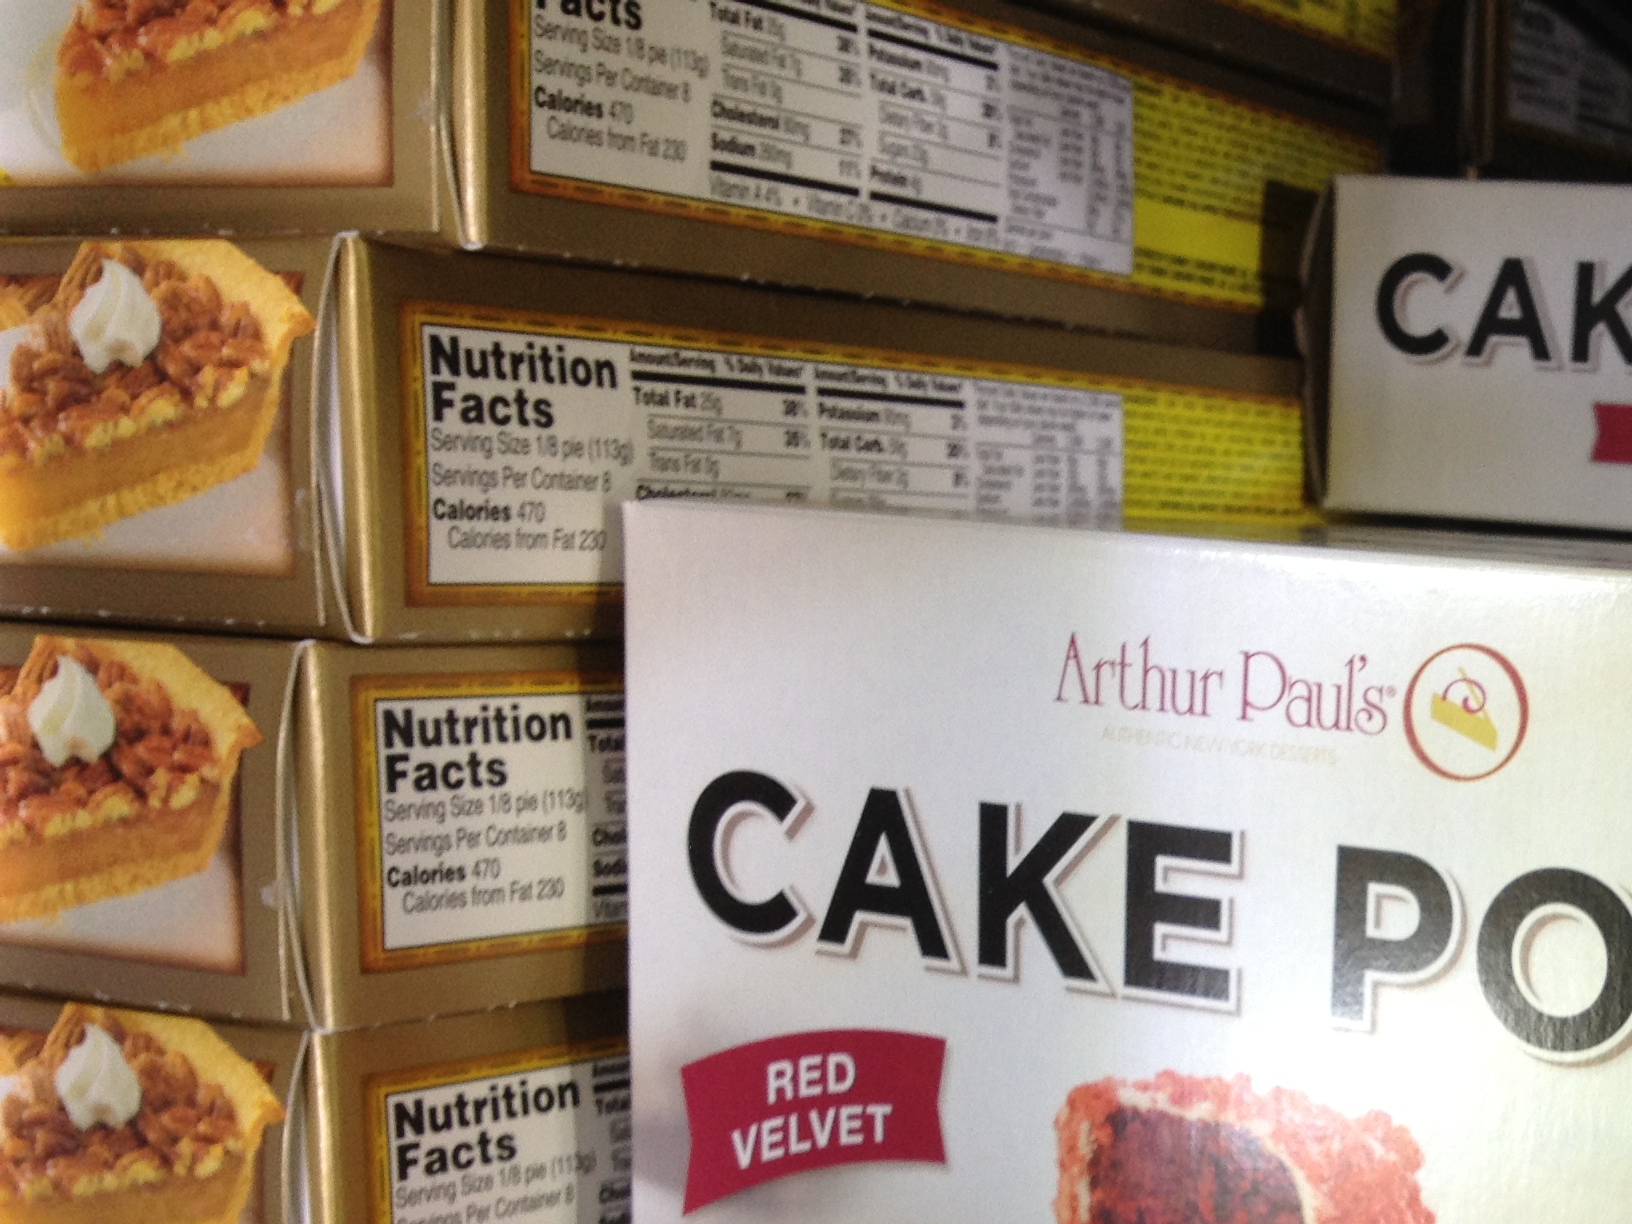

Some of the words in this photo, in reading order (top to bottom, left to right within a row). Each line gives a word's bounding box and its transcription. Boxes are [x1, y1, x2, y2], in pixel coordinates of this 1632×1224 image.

[535, 0, 643, 30] acts
[535, 86, 603, 119] Calories
[429, 333, 618, 390] Nutrition
[431, 381, 555, 429] Facts
[633, 386, 670, 407] Total
[431, 427, 493, 460] Serving
[497, 430, 530, 456] Size
[431, 462, 499, 494] Servings
[433, 498, 512, 523] Calories
[448, 525, 511, 551] Calories
[1054, 631, 1226, 718] Arthur
[1236, 649, 1390, 736] Paul's
[382, 703, 573, 750] Nutrition
[385, 751, 508, 793] Facts
[384, 797, 447, 824] Serving
[450, 794, 484, 818] Size
[385, 831, 451, 857] Servings
[456, 827, 481, 849] Per
[485, 823, 555, 847] Container
[387, 861, 467, 888] Calories
[402, 889, 467, 914] Calories
[687, 770, 1244, 1014] CAKE
[766, 1053, 857, 1105] RED
[394, 1079, 580, 1140] Nutrition
[730, 1104, 894, 1170] VELVET
[397, 1131, 517, 1182] Facts
